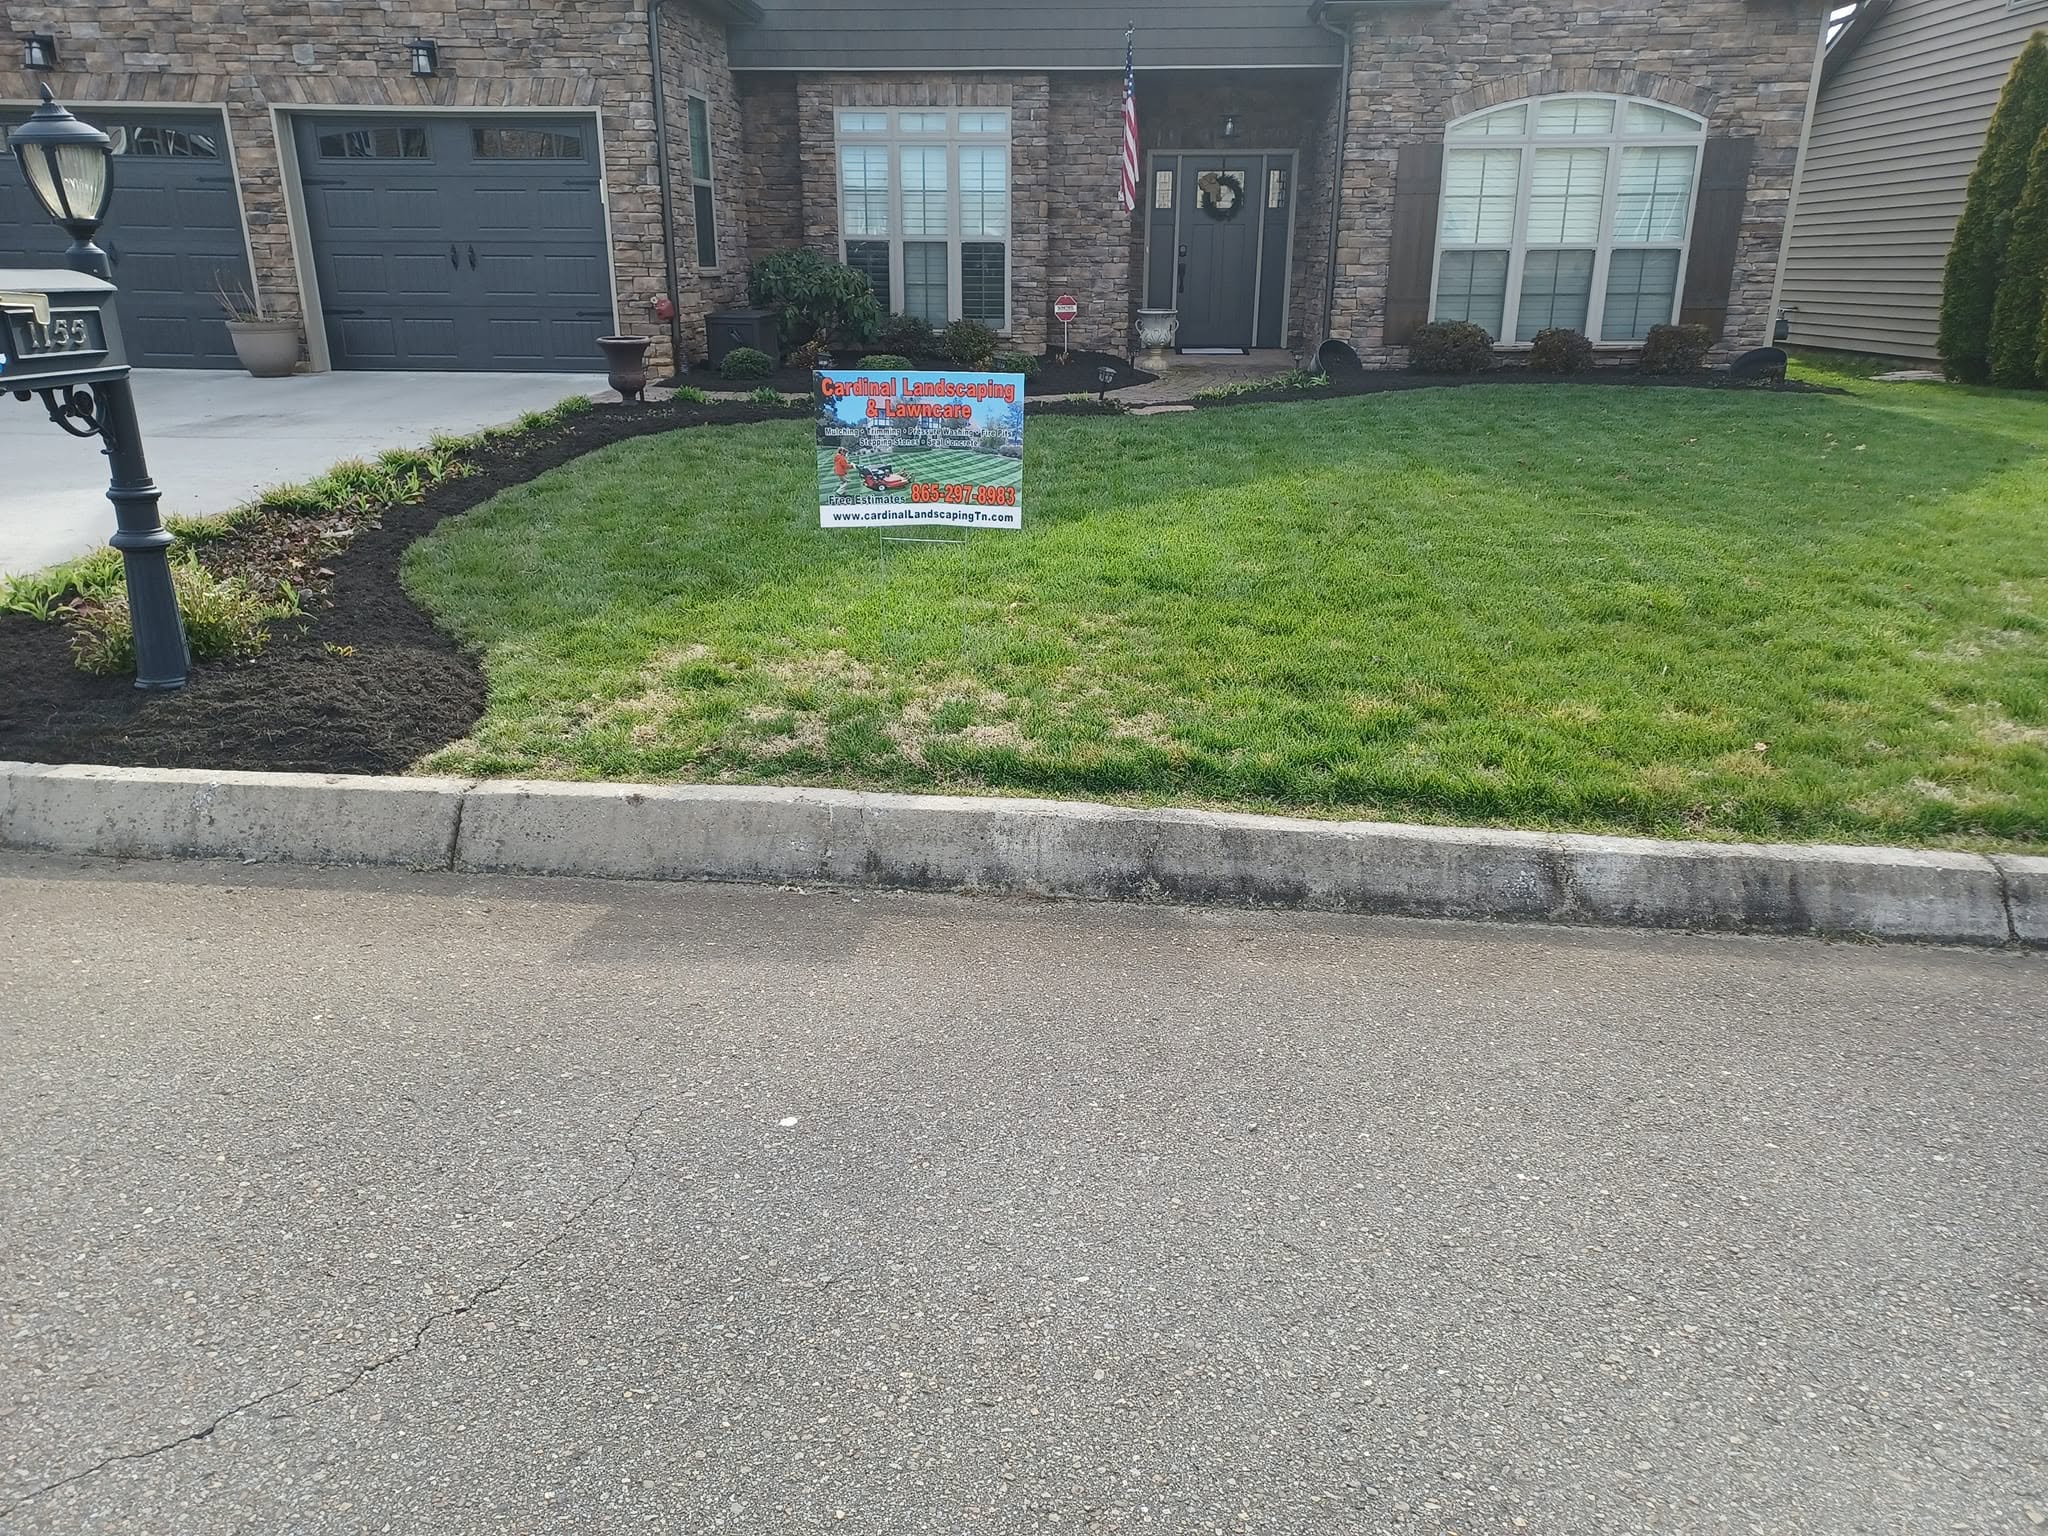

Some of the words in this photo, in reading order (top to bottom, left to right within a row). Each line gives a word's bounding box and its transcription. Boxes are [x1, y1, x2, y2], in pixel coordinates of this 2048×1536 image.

[27, 319, 87, 349] 1155
[821, 377, 896, 397] Cardinal
[902, 378, 1016, 403] Landscaping
[866, 399, 879, 418] &
[885, 399, 972, 419] Lawncare
[825, 427, 860, 437] Mulching
[908, 427, 941, 436] Pressure
[942, 427, 974, 437] Washing
[981, 428, 997, 437] Fire
[859, 438, 892, 448] Stepping
[894, 438, 919, 447] Stones
[927, 439, 943, 447] Seal
[945, 439, 978, 447] Concrete
[828, 495, 852, 505] Free
[855, 495, 905, 505] Estimates
[911, 483, 1016, 506] 865-297-8983
[833, 509, 1014, 523] www.cardinalLandscapingTn.com
